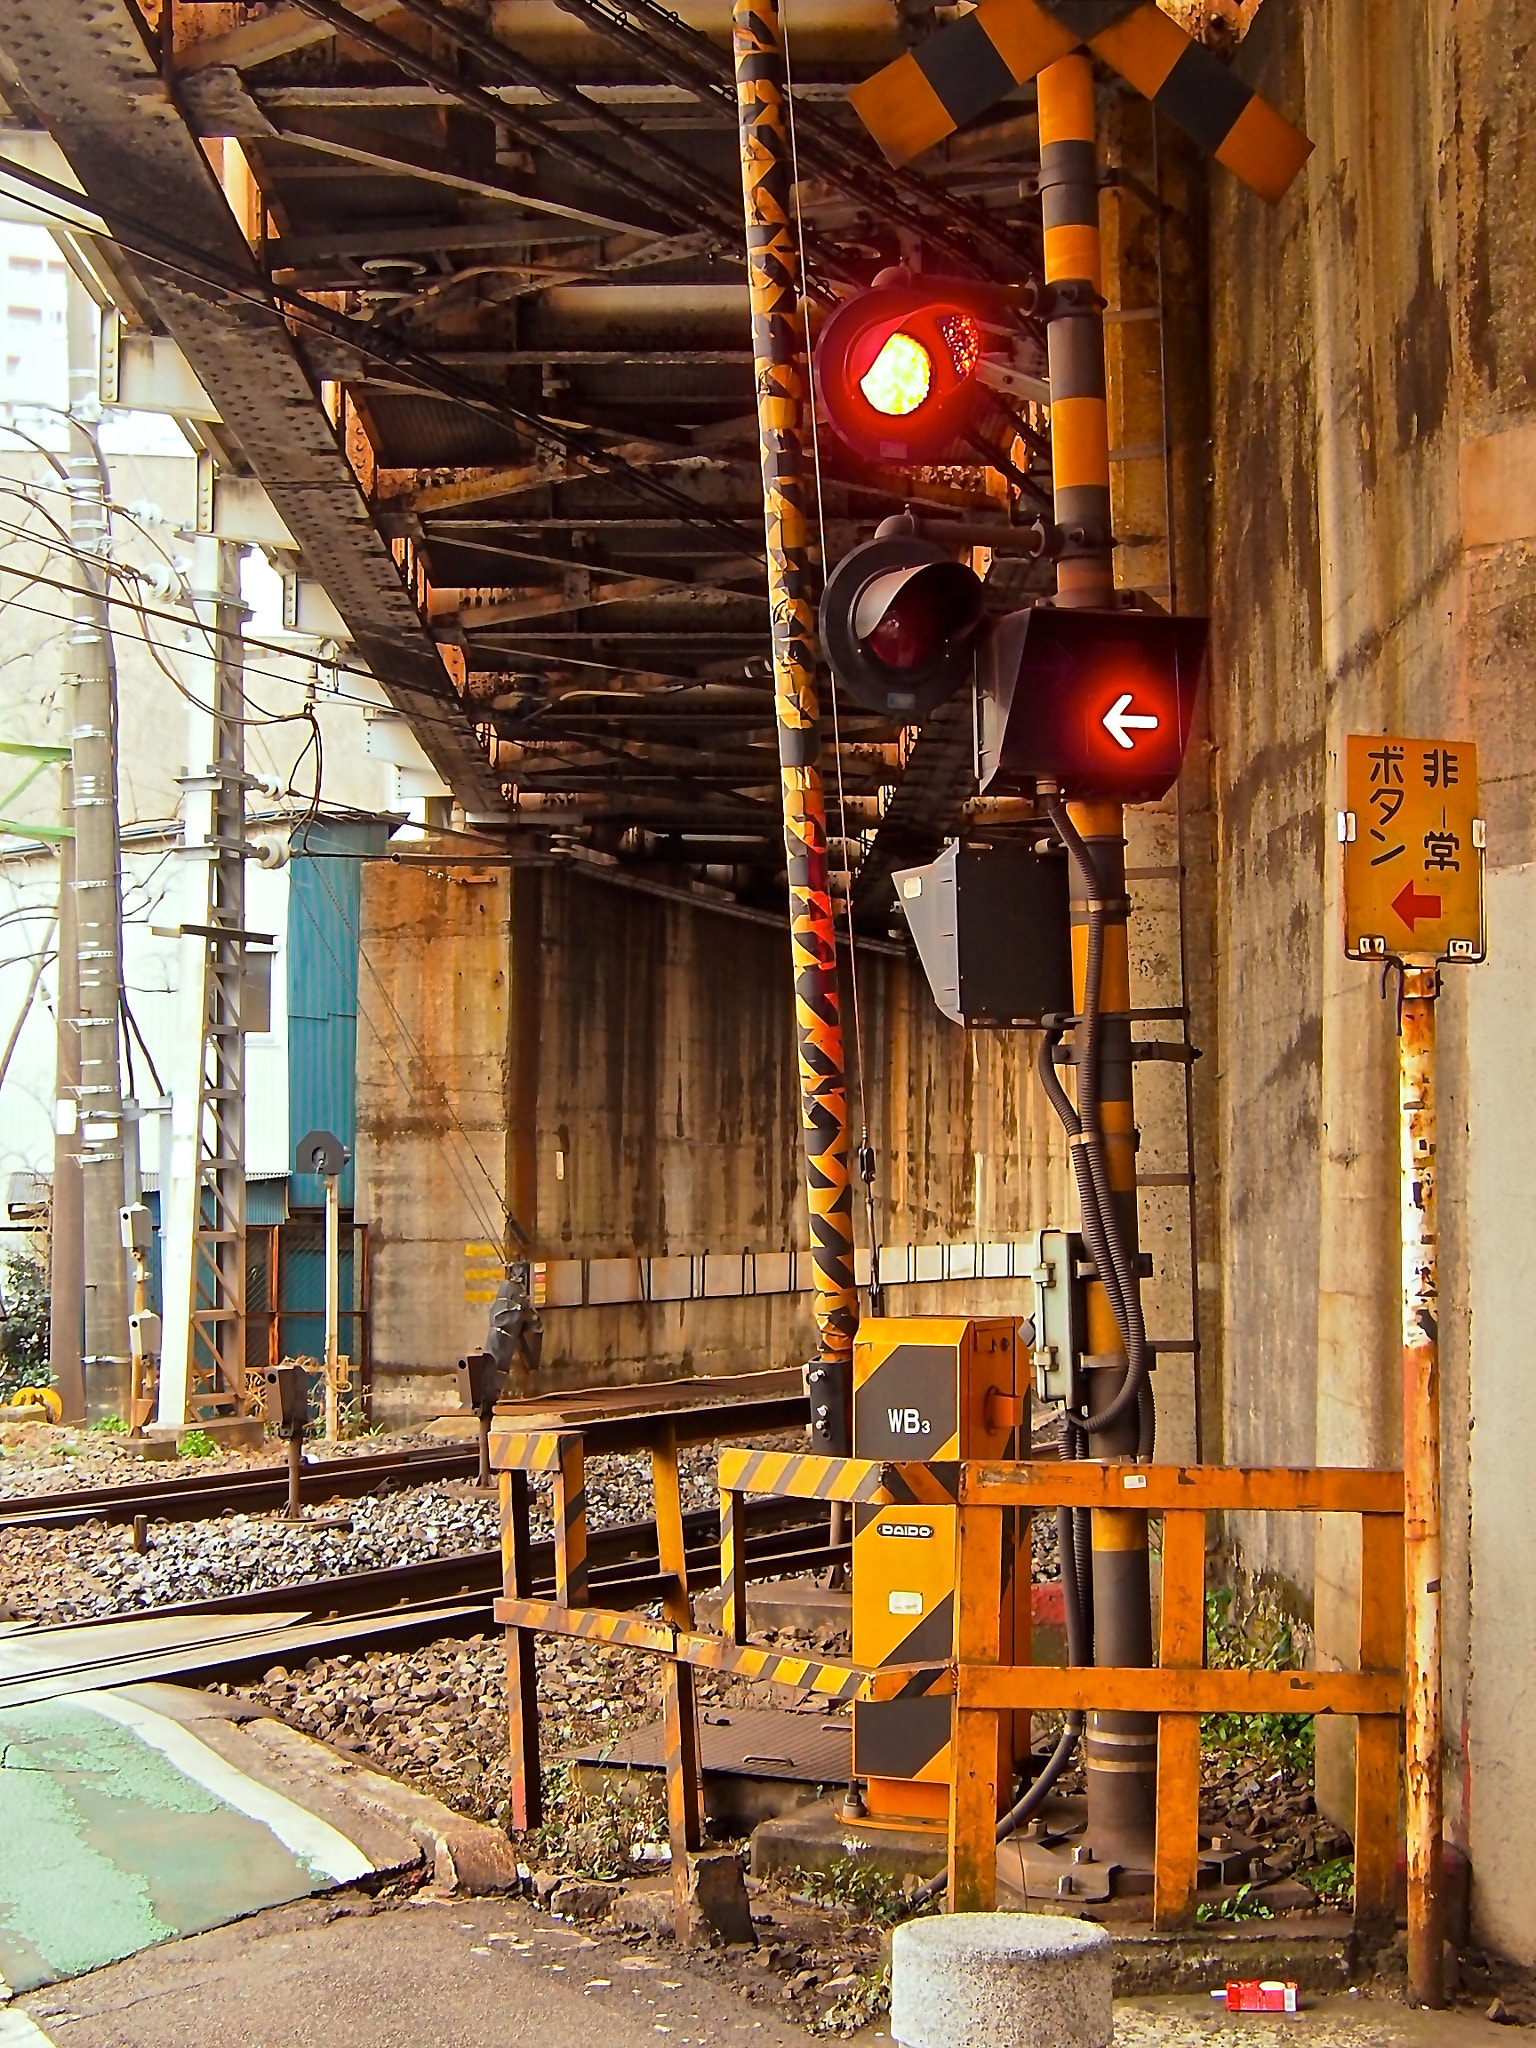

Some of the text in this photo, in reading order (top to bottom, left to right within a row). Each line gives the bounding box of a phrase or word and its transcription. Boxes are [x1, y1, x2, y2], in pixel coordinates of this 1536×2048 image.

[1367, 745, 1405, 867] ボタン
[887, 1408, 931, 1434] WB3
[881, 1524, 931, 1537] DAIDO
